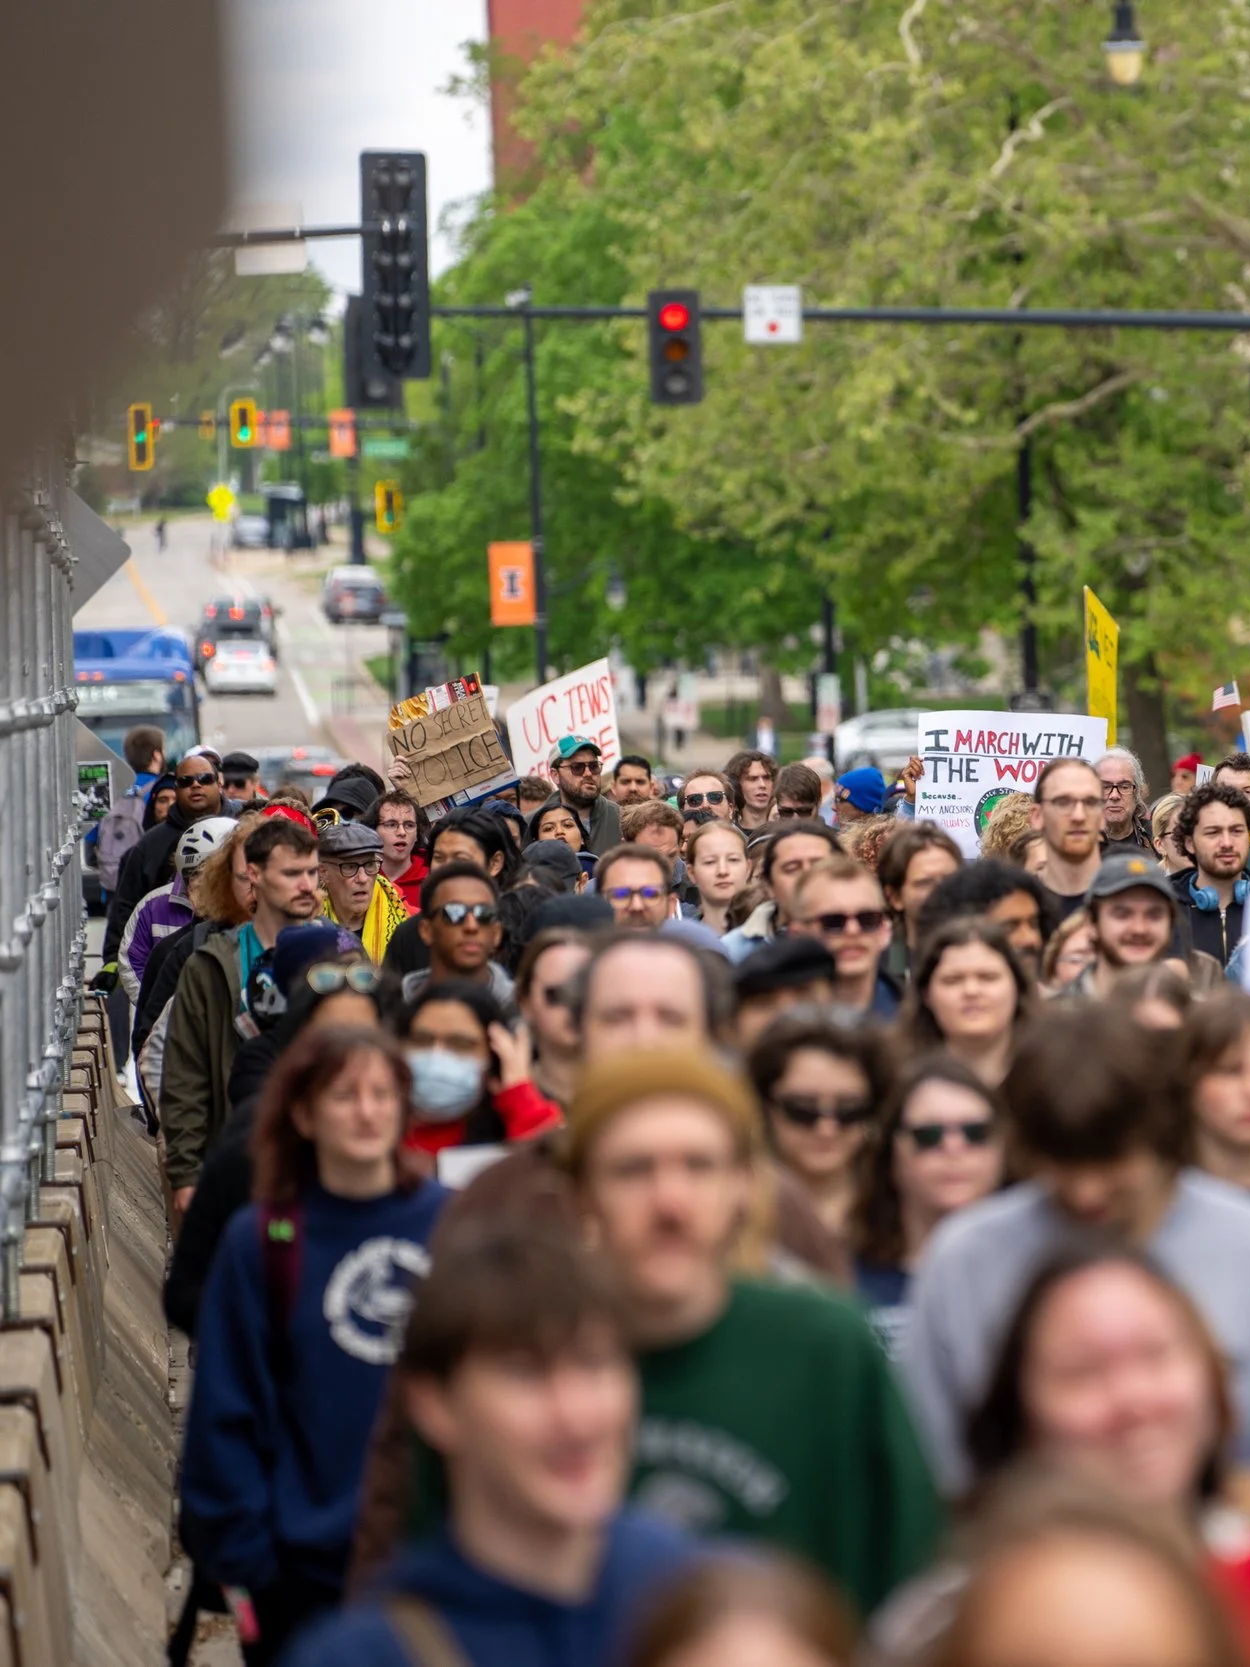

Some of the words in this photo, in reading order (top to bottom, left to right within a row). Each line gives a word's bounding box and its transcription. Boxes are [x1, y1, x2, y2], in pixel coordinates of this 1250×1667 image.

[392, 721, 427, 755] NO
[431, 697, 487, 740] SECRET
[522, 694, 559, 754] UC
[563, 676, 608, 732] JEWS
[406, 730, 503, 795] POLICE
[924, 729, 949, 752] I
[954, 729, 1019, 755] MARCH
[1022, 732, 1084, 756] WITH
[924, 756, 980, 783] THE
[918, 805, 936, 815] MY
[939, 805, 974, 815] ANCESTORS
